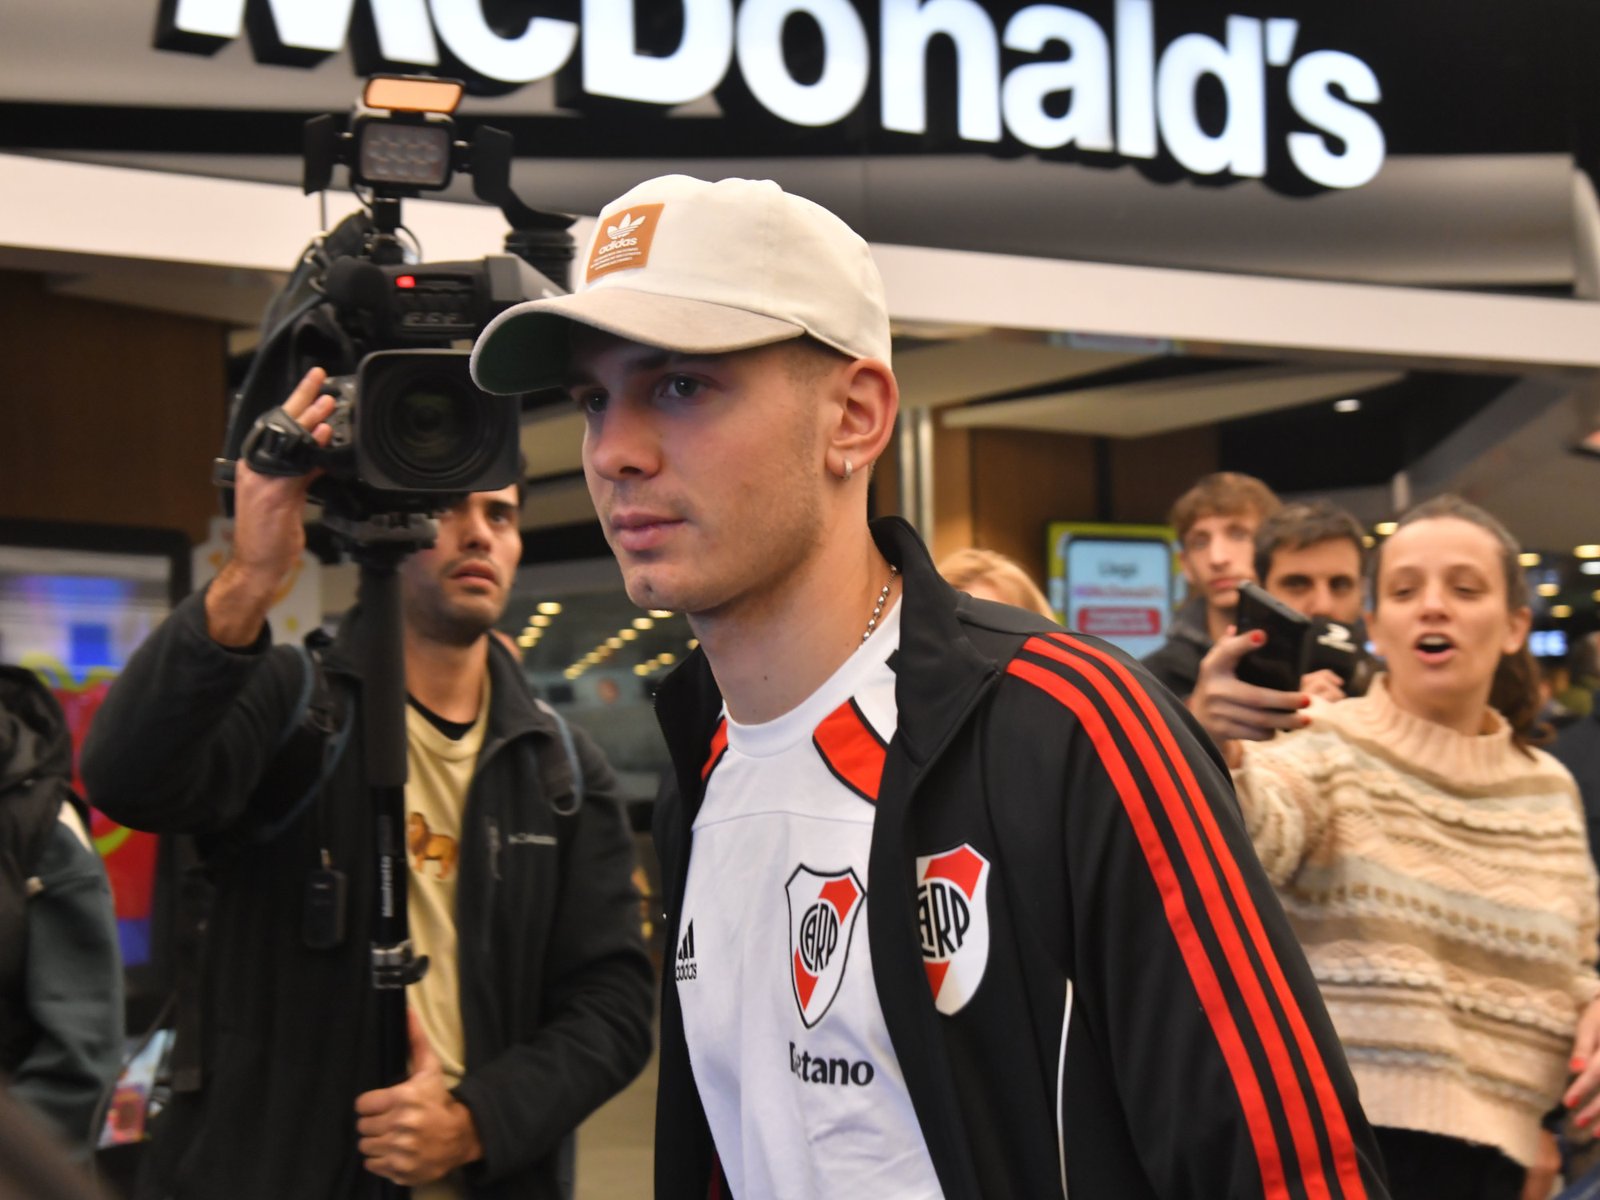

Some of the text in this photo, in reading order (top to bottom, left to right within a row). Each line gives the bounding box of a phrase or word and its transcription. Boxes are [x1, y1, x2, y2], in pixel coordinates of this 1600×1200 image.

[174, 0, 1386, 189] cDonald's
[598, 237, 638, 255] adidas
[800, 902, 838, 972] CARP
[789, 1040, 874, 1087] tano
